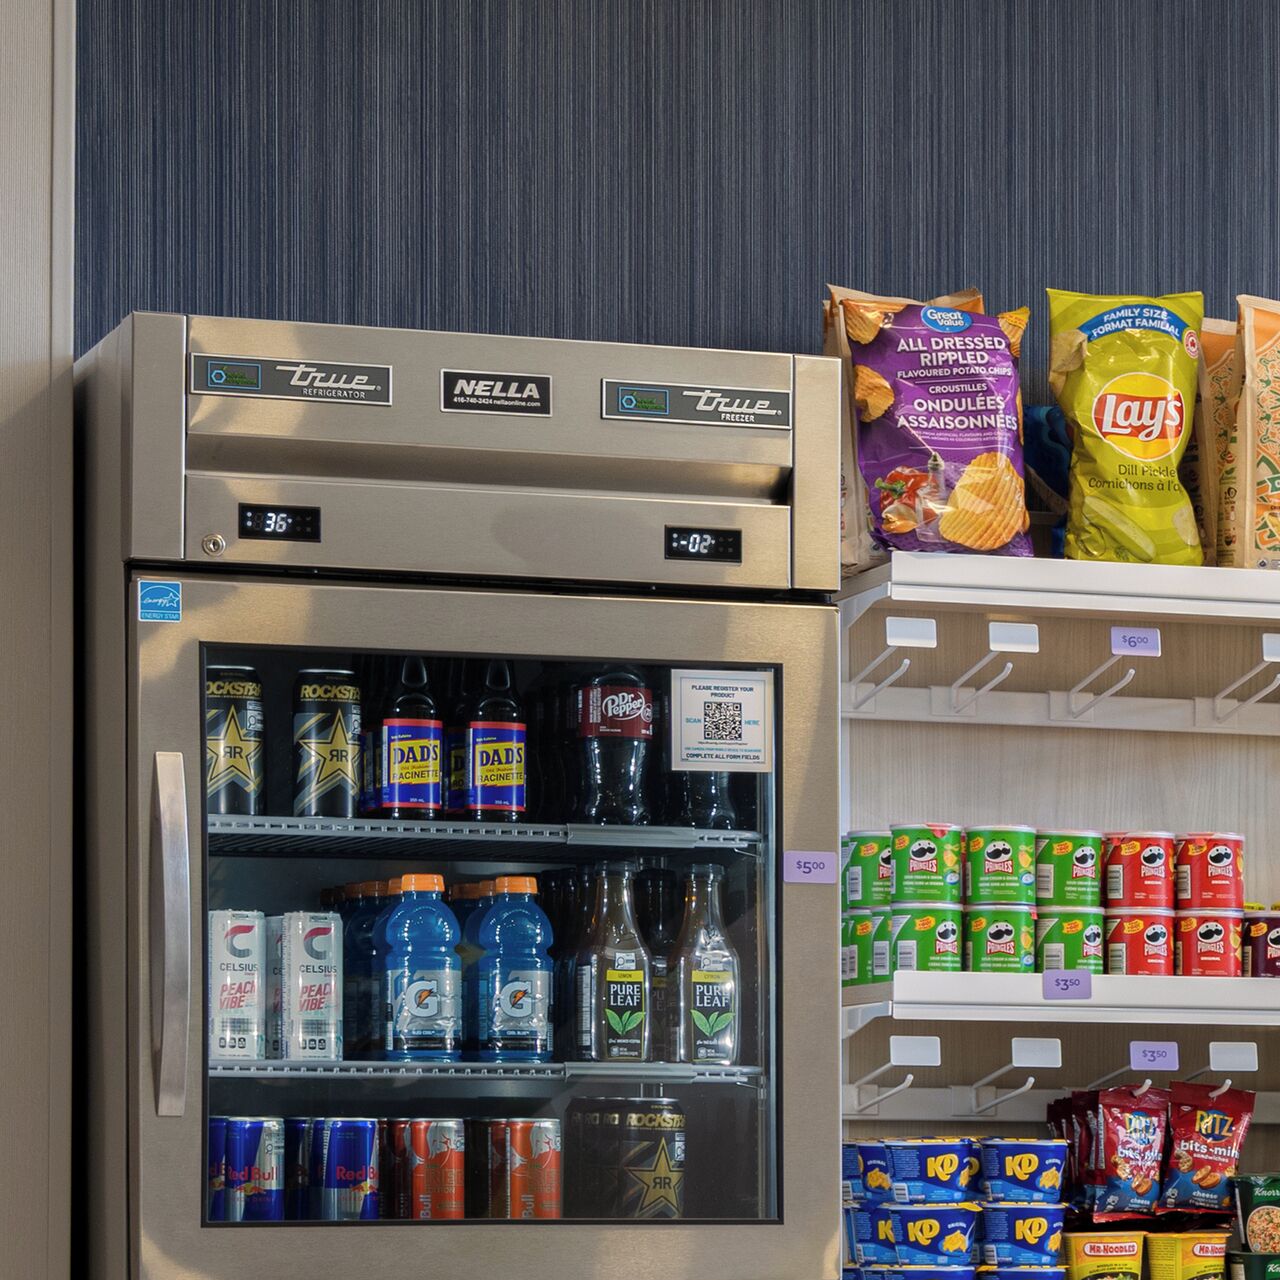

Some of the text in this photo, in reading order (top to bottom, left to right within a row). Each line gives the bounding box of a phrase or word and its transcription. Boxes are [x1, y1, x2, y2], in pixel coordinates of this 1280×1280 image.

[926, 309, 963, 321] Great
[1104, 307, 1168, 321] FAMILY SIZE
[936, 317, 965, 327] Value
[1092, 319, 1180, 337] FORMAT FAMILIAL
[897, 337, 1006, 352] ALL DRESSED
[920, 351, 989, 366] RIPPLED
[897, 366, 1012, 379] FLAVOURED POTATO CHIPS
[303, 388, 366, 399] REFRIGERATOR
[454, 379, 540, 398] NELLA
[929, 383, 987, 395] CROUSTILLES
[493, 398, 541, 408] nellaonline.com
[913, 394, 1006, 412] ONDULÉES
[721, 413, 755, 423] FREEZER
[897, 412, 1018, 430] ASSAISONNÉES
[1118, 465, 1177, 477] Dill Pickle
[605, 697, 643, 719] Pepper
[909, 859, 937, 872] PRINGLES
[219, 962, 258, 973] CELSIUS
[610, 984, 641, 996] PURE
[218, 995, 246, 1010] VIBE
[610, 995, 641, 1006] LEAF
[927, 1154, 959, 1181] KD
